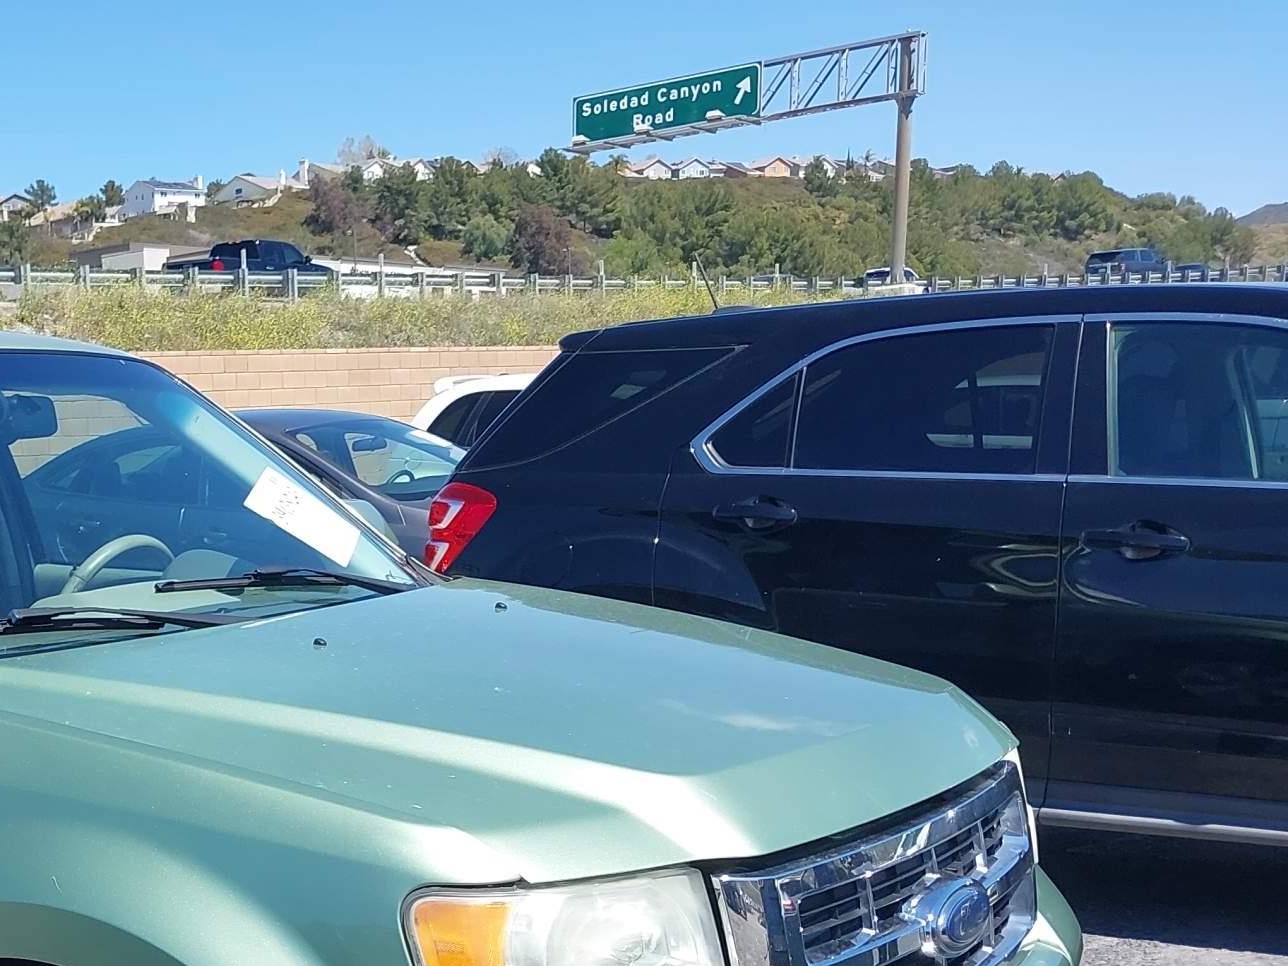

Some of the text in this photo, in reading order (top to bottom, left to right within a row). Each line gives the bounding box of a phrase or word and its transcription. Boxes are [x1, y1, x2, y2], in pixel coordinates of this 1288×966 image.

[581, 80, 722, 116] Soledad Canyon
[632, 107, 675, 128] Road
